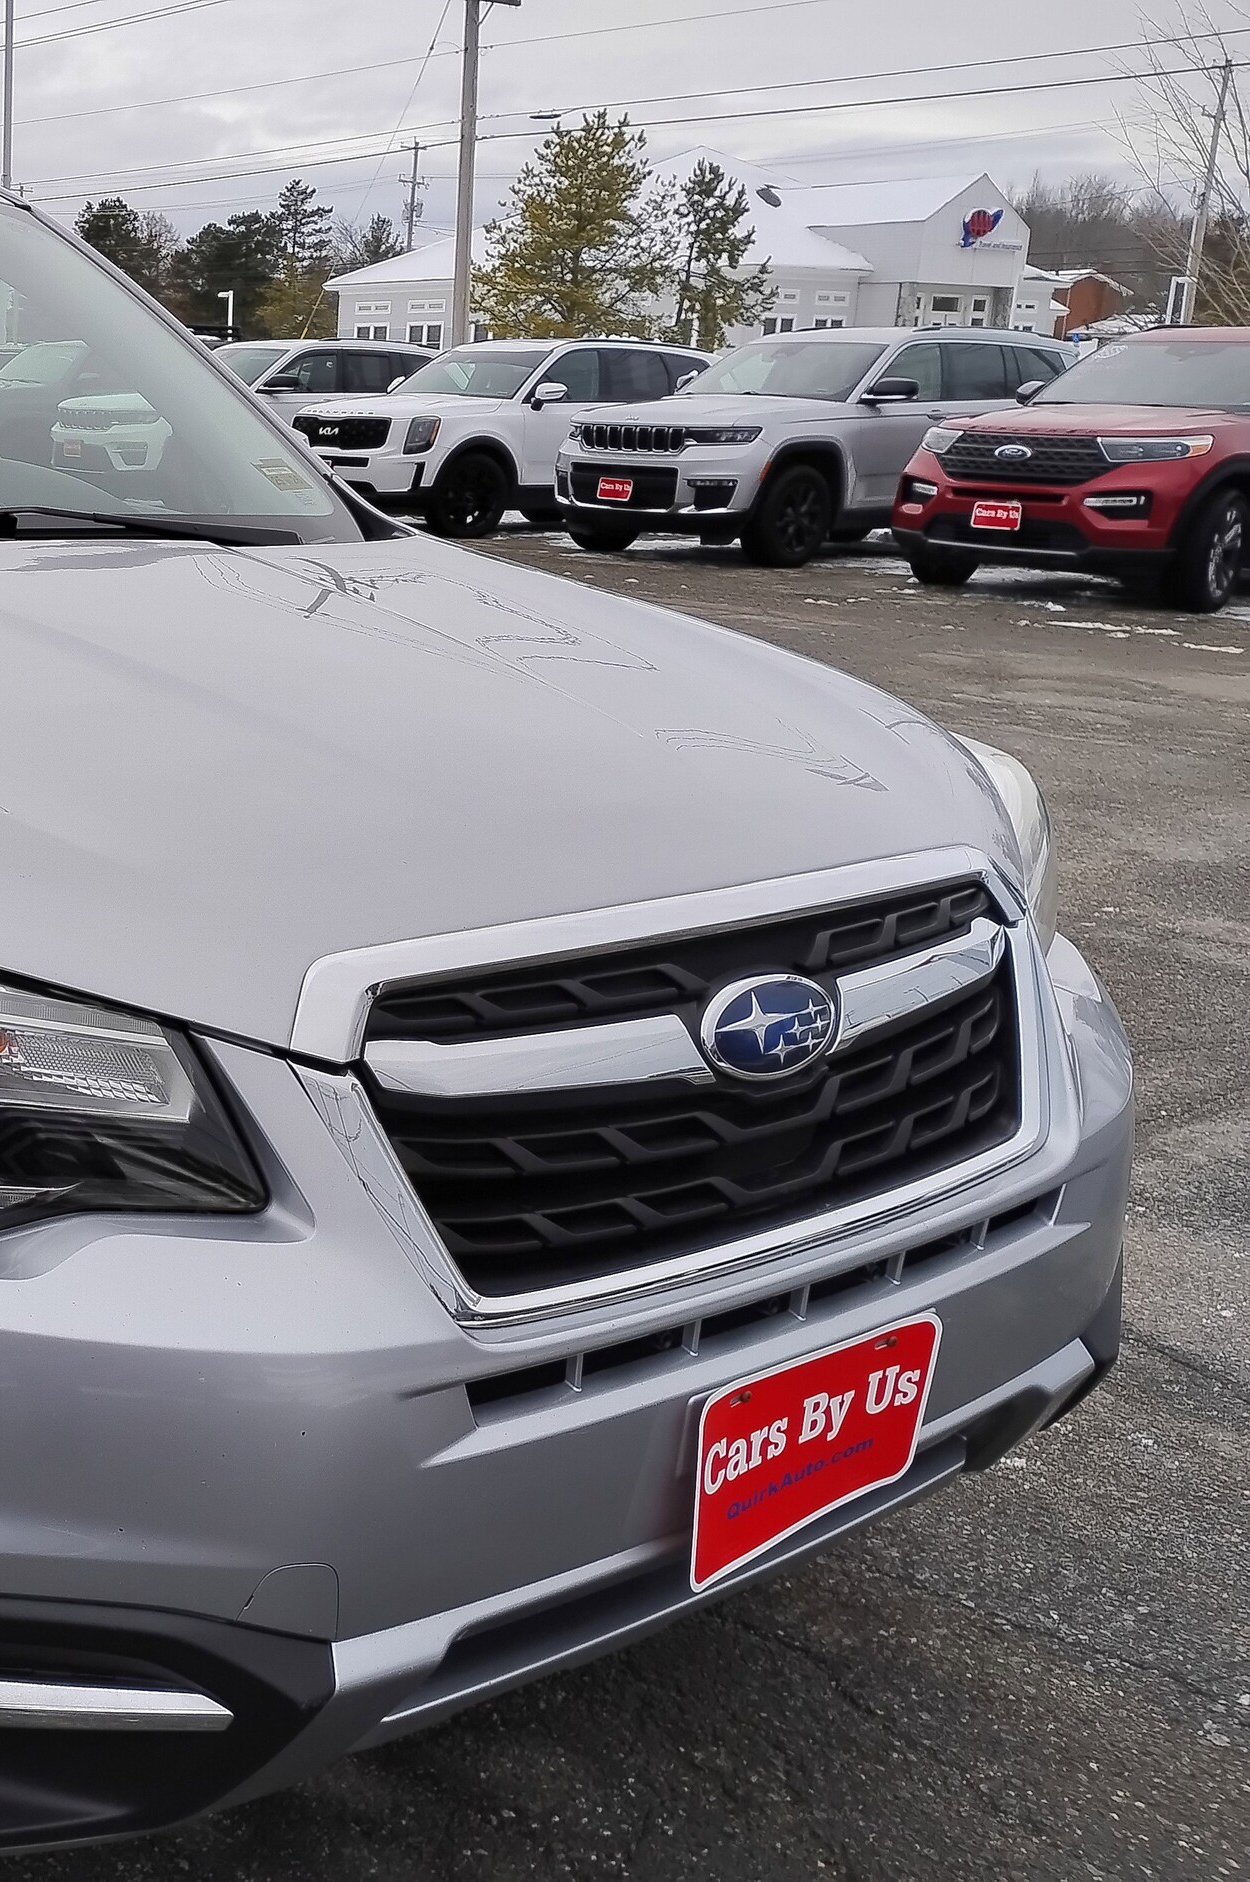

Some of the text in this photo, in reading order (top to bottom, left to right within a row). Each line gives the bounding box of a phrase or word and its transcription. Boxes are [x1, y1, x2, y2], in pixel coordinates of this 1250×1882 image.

[704, 1365, 920, 1495] Cars By Us
[726, 1438, 874, 1520] QuirkAuto.com
